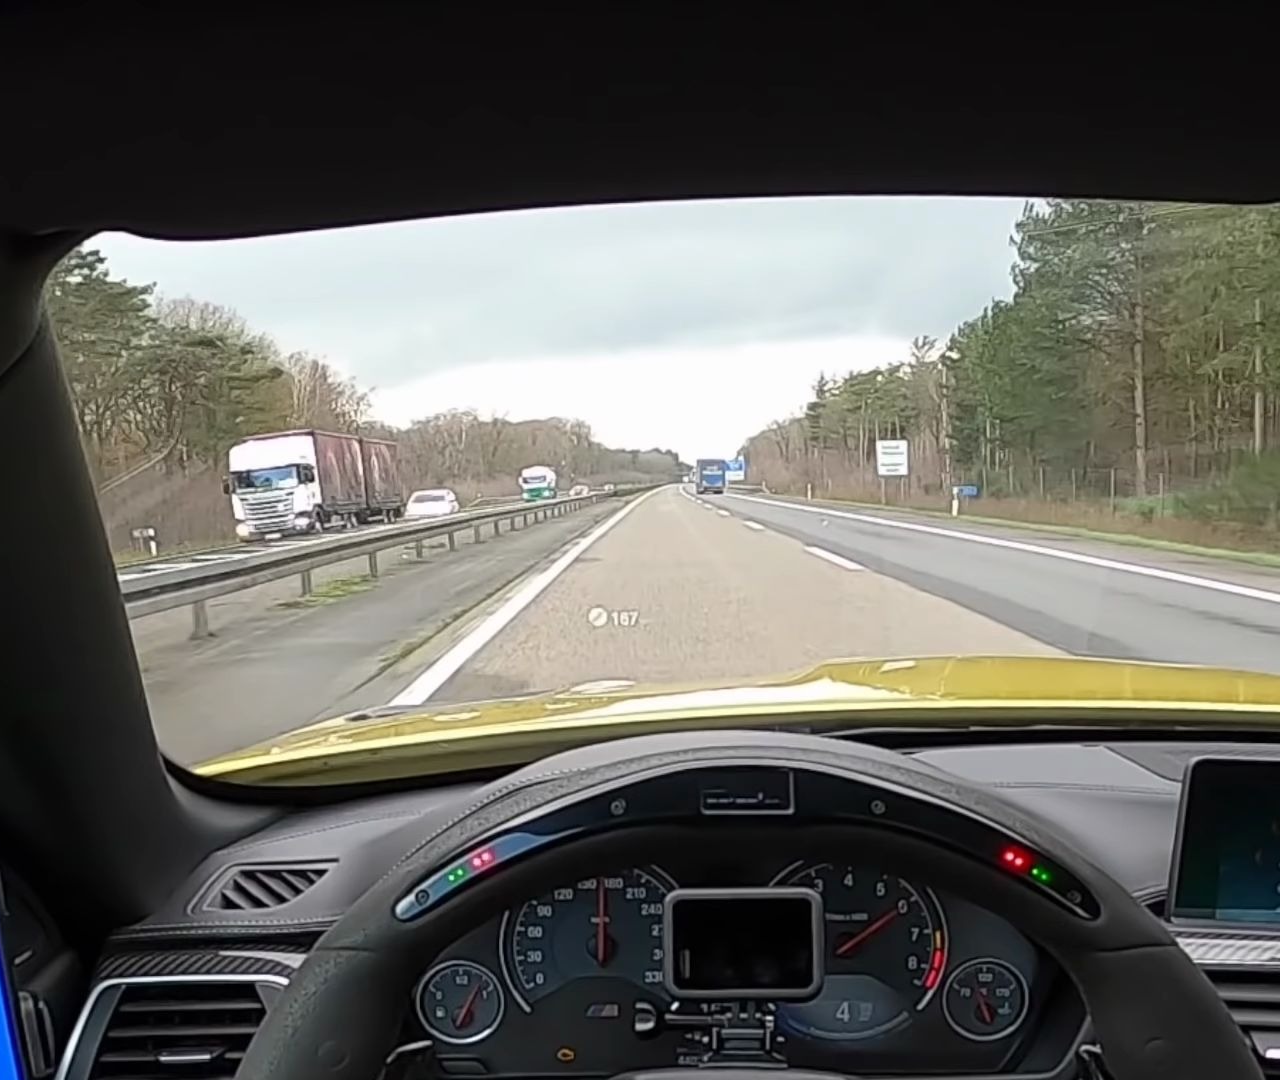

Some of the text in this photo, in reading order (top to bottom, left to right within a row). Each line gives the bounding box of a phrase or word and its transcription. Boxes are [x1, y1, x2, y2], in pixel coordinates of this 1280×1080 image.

[625, 888, 646, 899] 210
[876, 883, 885, 896] 5
[641, 904, 663, 915] 240
[911, 928, 919, 941] 7
[527, 951, 542, 963] 30
[836, 1001, 850, 1022] 4
